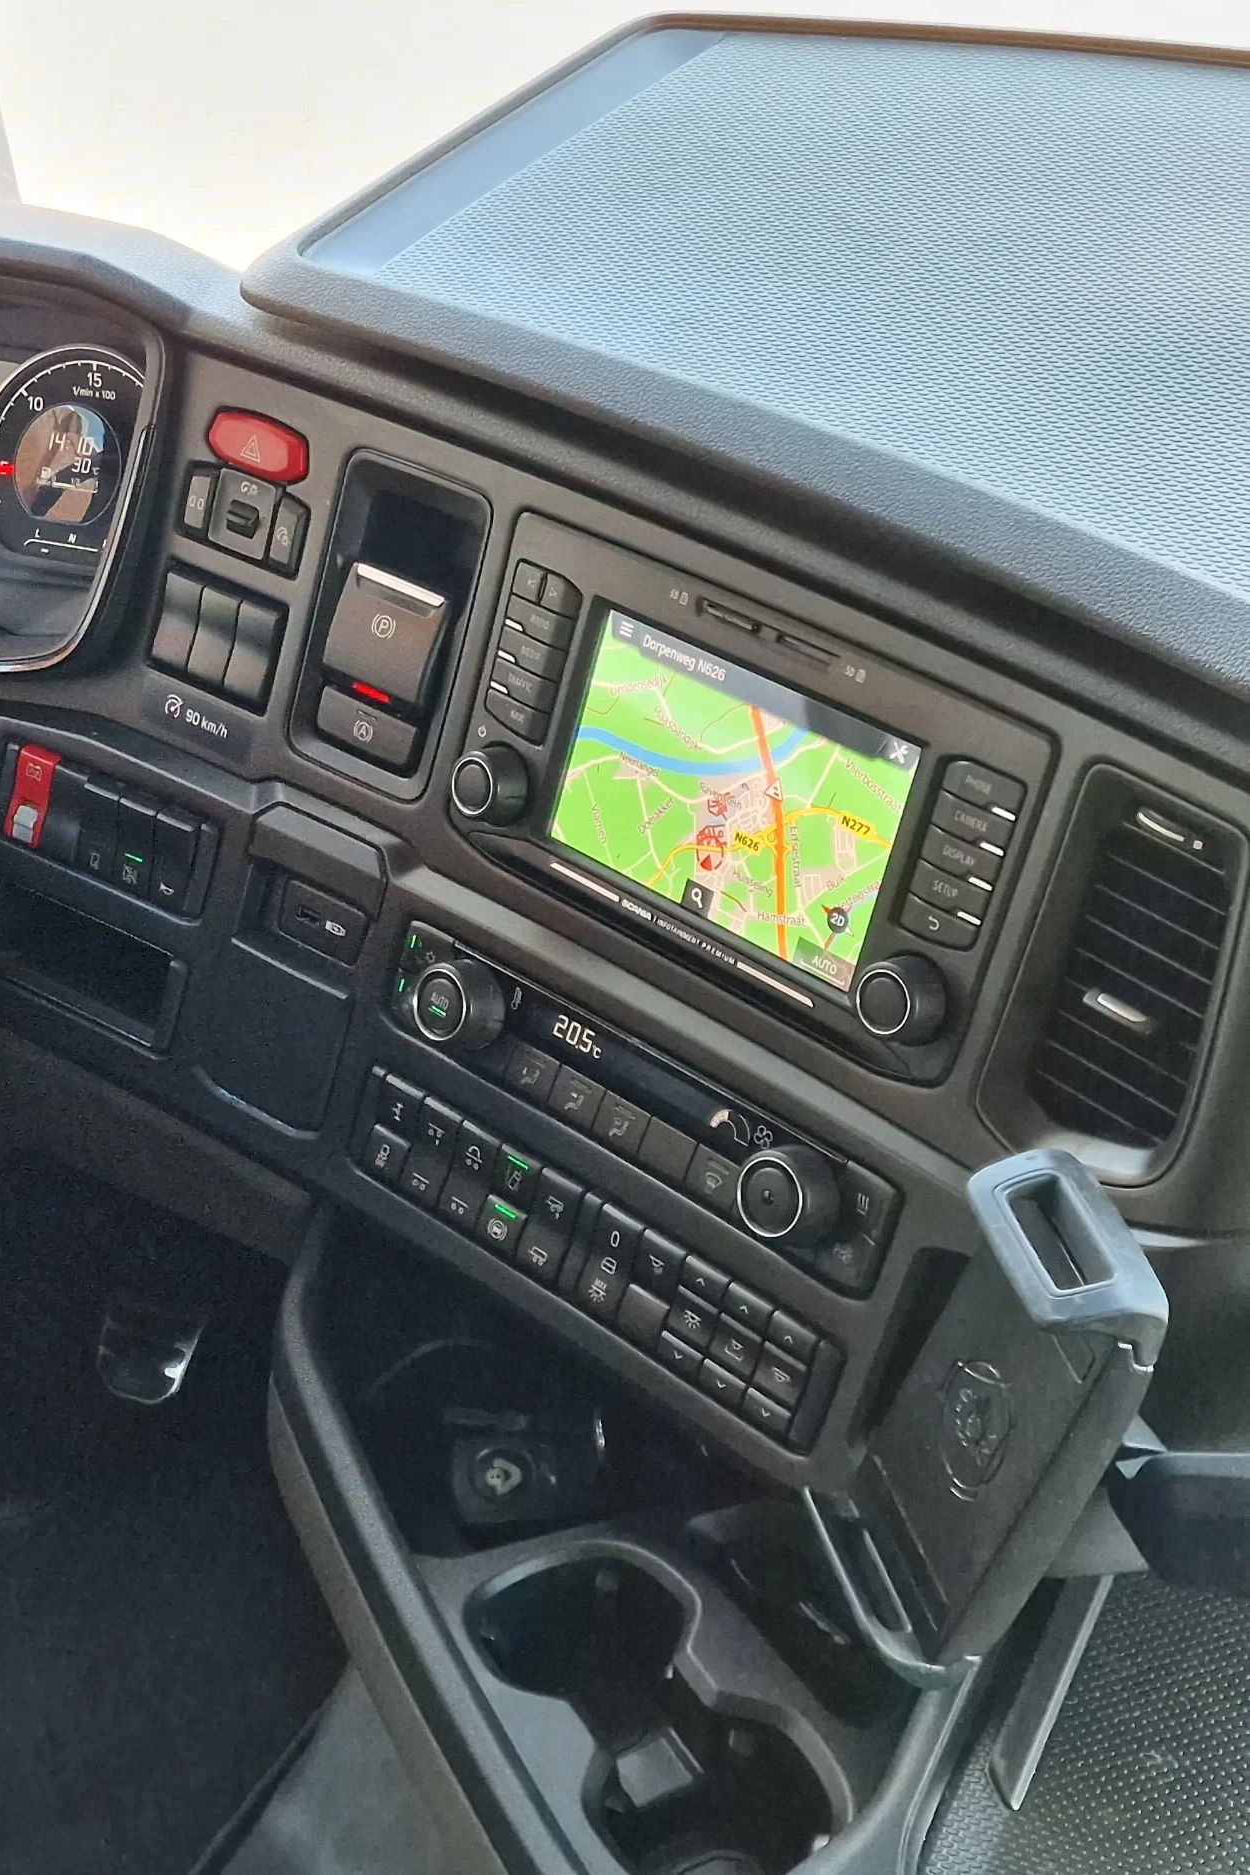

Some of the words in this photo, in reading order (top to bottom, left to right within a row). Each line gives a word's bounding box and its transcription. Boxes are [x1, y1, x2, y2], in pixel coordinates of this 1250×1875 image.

[86, 372, 103, 388] 15
[27, 395, 44, 412] 10
[71, 386, 94, 399] 1/min
[101, 390, 116, 401] 100
[48, 431, 95, 456] 14:10
[34, 528, 41, 538] L
[68, 533, 77, 543] N
[642, 634, 697, 672] Dorpenweg
[697, 658, 727, 683] N626
[508, 672, 534, 694] TRAFFIC
[185, 708, 201, 726] 90
[200, 715, 228, 739] km/h
[845, 757, 903, 814] Vlierbosstraat
[840, 815, 872, 837] N277
[954, 810, 987, 833] CAMERA
[733, 832, 760, 852] N626
[942, 844, 976, 867] DISPLAY
[733, 869, 774, 899] Huisseling
[826, 873, 847, 892] Bulk
[932, 879, 959, 898] SETUP
[757, 910, 807, 927] Hamstraat
[830, 912, 846, 927] 2D
[621, 898, 652, 921] SCANIA
[701, 940, 736, 966] PREMIUM
[811, 955, 838, 976] AUTO
[430, 991, 450, 1011] AUTO
